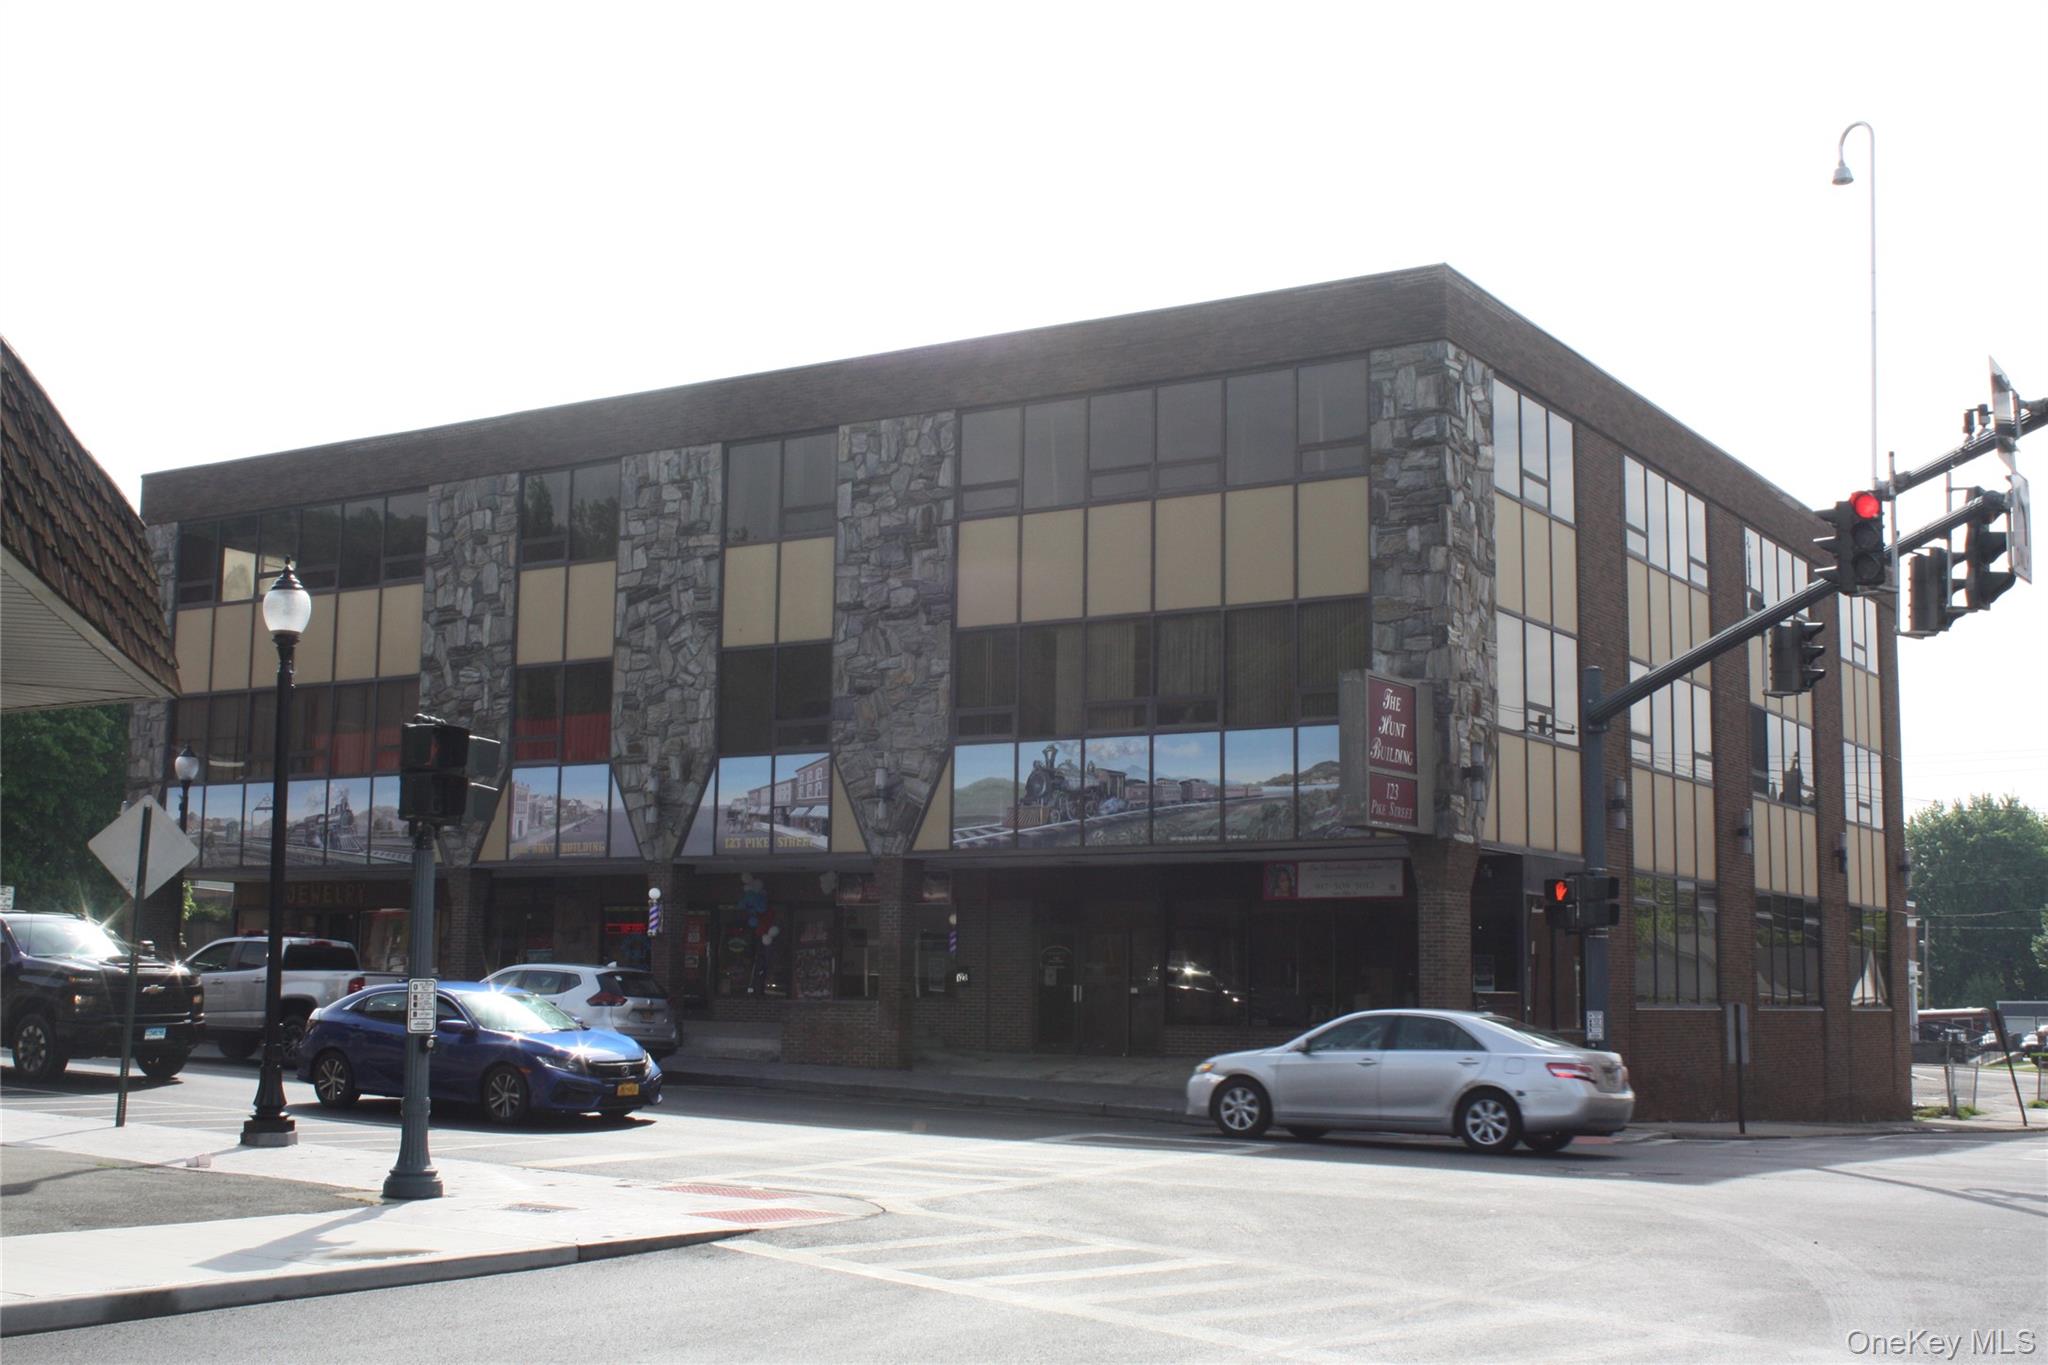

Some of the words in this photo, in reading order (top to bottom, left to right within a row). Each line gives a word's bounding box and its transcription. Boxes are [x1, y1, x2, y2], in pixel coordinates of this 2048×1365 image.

[1382, 688, 1402, 712] THE
[1378, 714, 1407, 738] HUNT
[1369, 737, 1414, 766] BUILDING
[1385, 783, 1399, 801] 123
[560, 841, 606, 854] BUILDING
[744, 837, 770, 849] PIKE
[286, 883, 367, 906] JEWELRY
